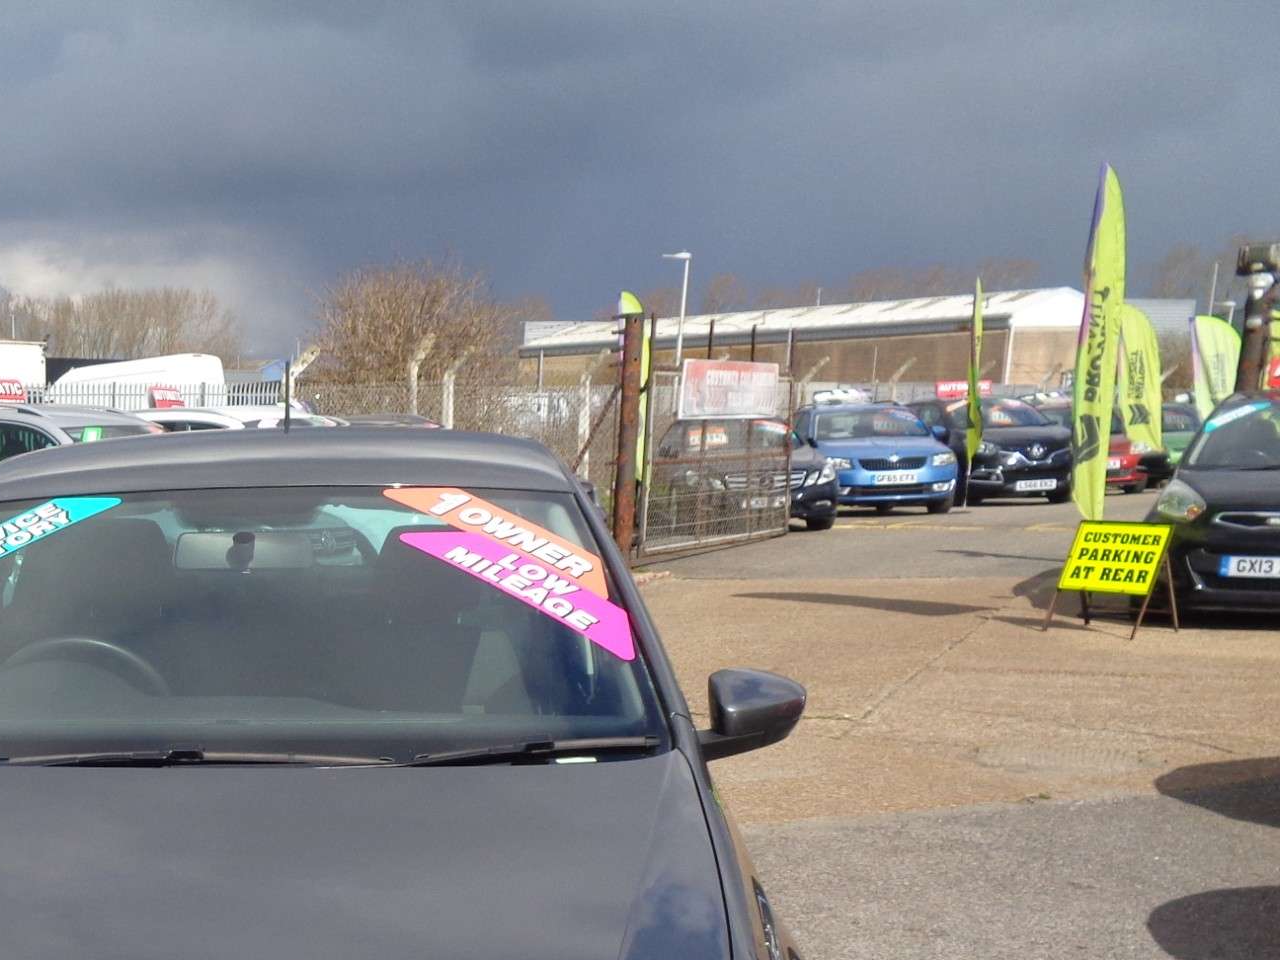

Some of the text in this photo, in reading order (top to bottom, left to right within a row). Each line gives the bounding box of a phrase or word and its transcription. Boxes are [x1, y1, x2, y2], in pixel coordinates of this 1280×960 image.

[428, 493, 594, 579] 1 OWNER
[1083, 531, 1162, 546] CUSTOMER
[1077, 548, 1156, 565] PARKING
[497, 552, 583, 596] LOW
[1070, 566, 1150, 584] AT REAR
[1236, 558, 1274, 574] GX13
[443, 545, 600, 631] MILEAGE
